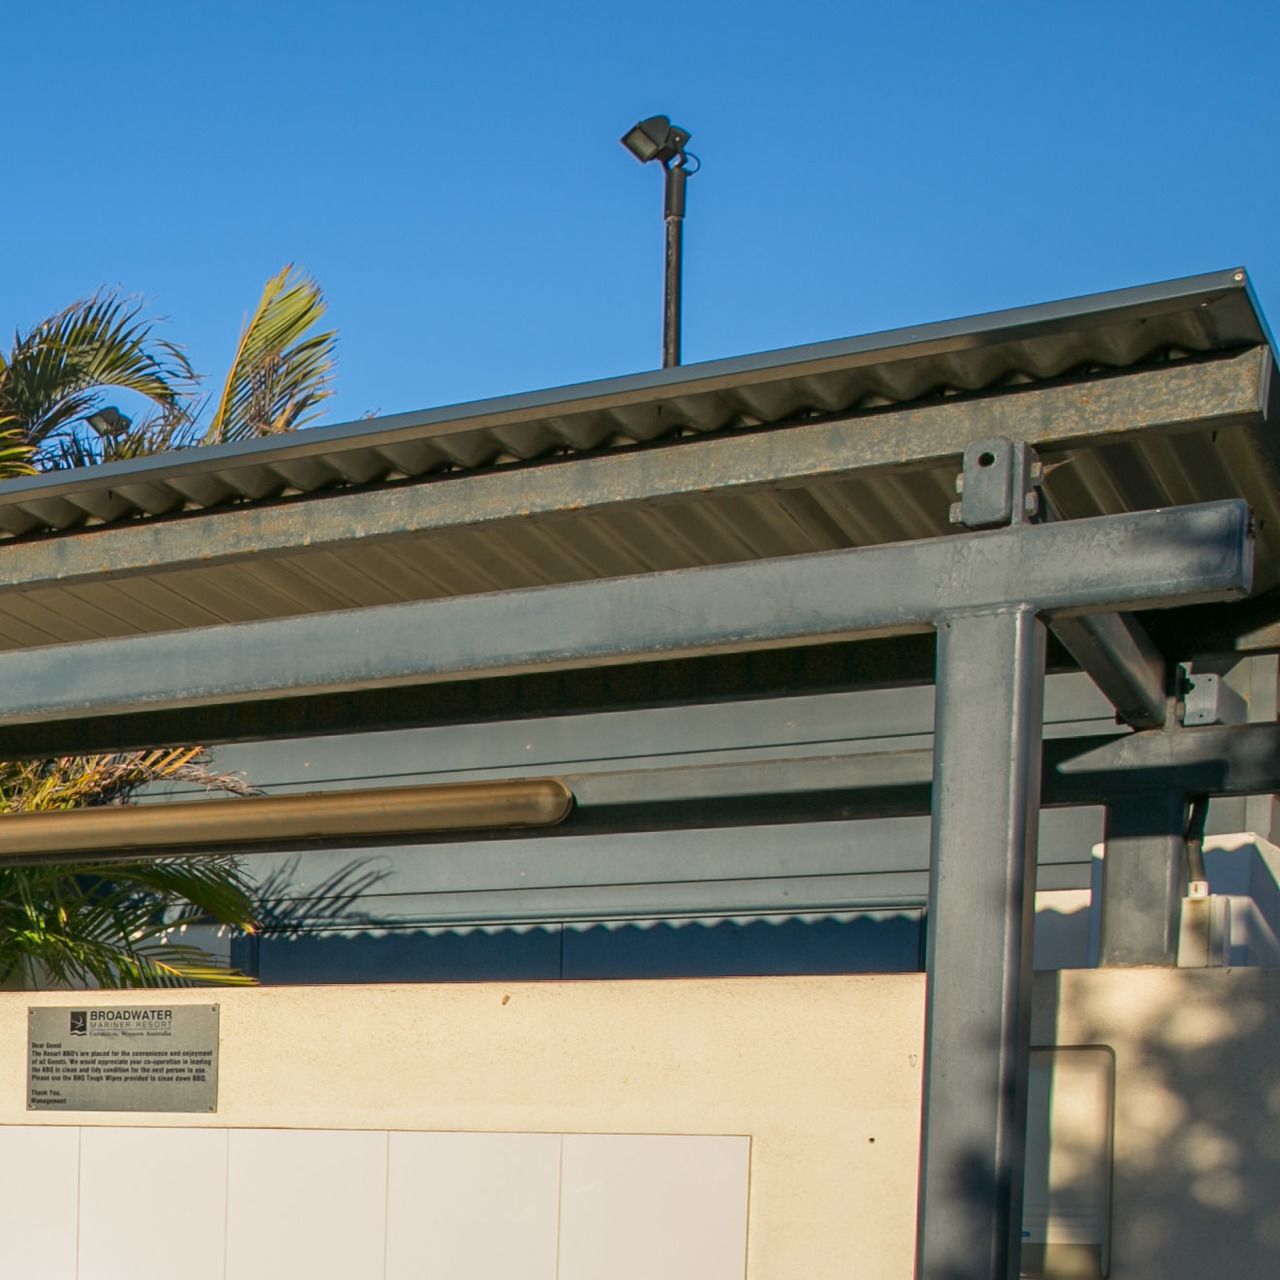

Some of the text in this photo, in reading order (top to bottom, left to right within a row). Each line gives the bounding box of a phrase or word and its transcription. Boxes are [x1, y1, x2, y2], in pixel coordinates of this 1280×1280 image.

[90, 1009, 172, 1021] BROADWATER
[90, 1020, 172, 1029] MARINER RESORT
